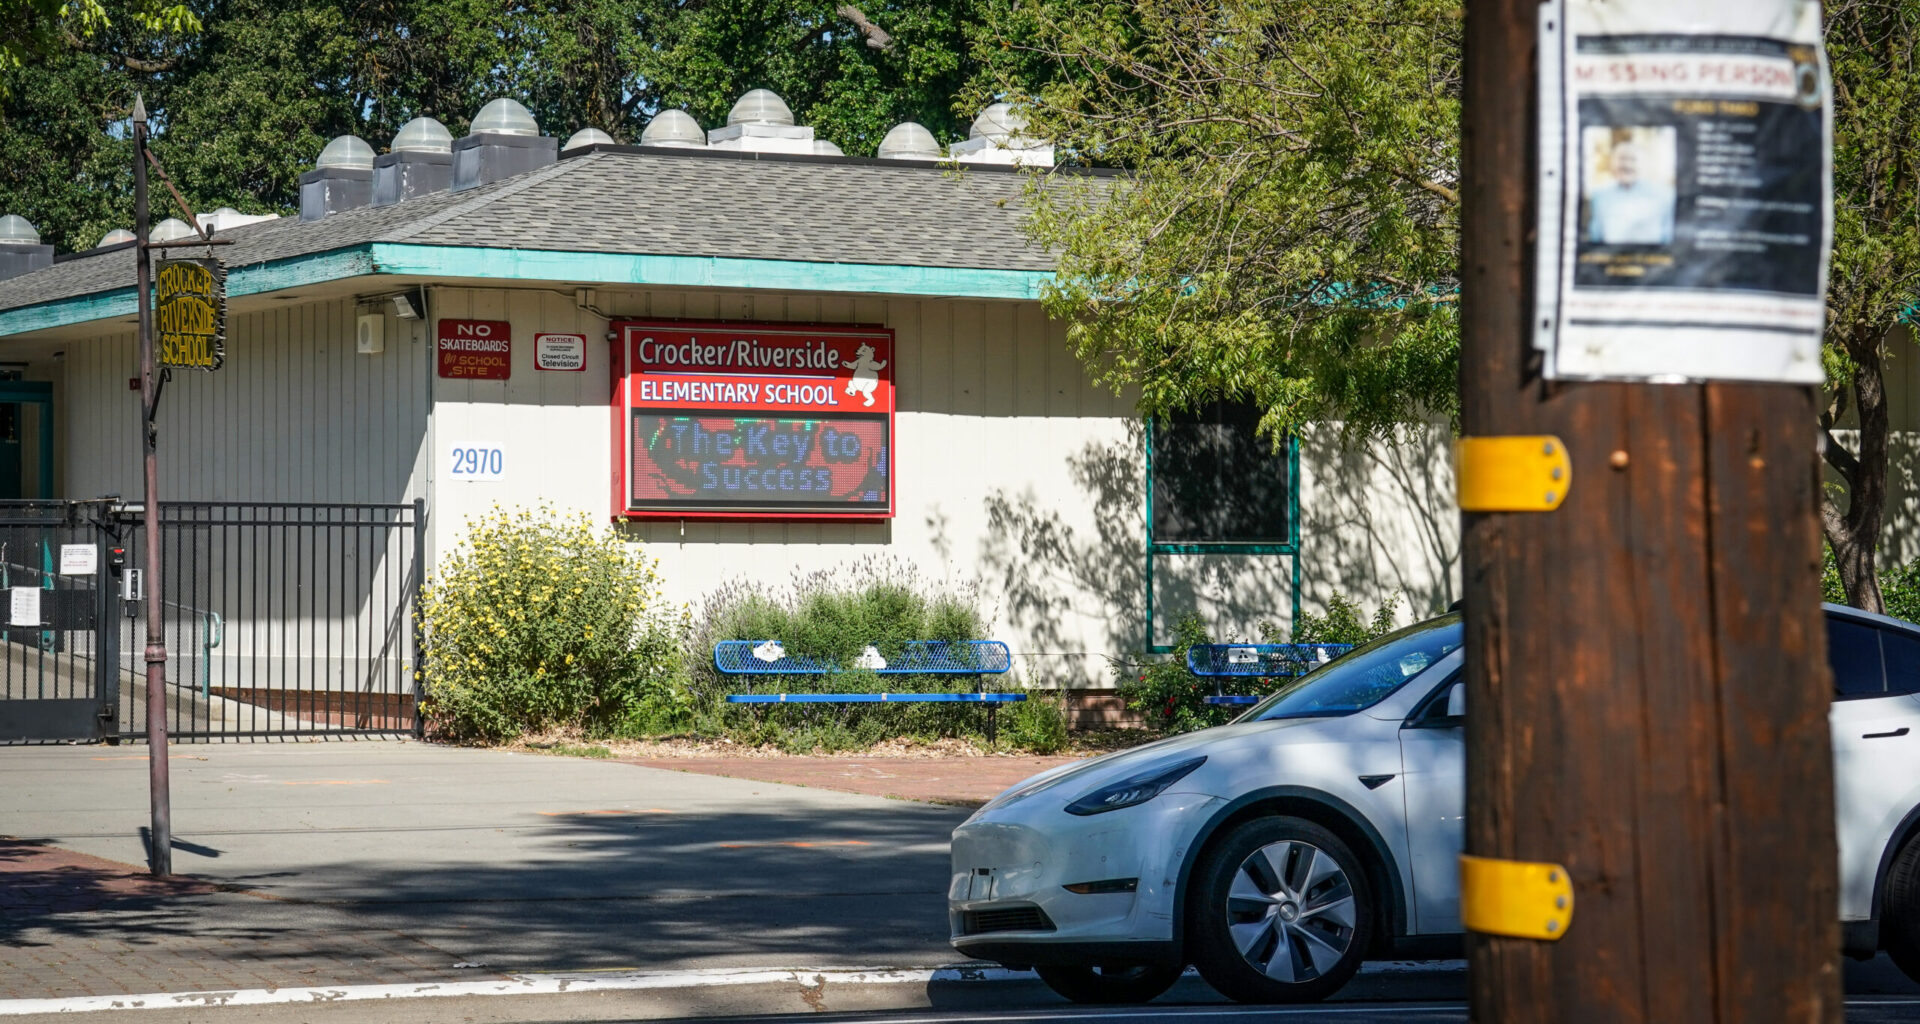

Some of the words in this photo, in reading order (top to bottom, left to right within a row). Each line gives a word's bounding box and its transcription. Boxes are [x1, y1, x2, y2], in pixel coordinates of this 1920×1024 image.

[1700, 63, 1794, 88] PERSON
[160, 264, 212, 305] CROCKER
[160, 296, 216, 334] RIVERSIDE
[457, 324, 491, 336] NO
[162, 333, 213, 367] SCHOOL
[440, 338, 509, 352] SKATEBOARDS
[638, 337, 840, 370] Crocker/Riverside
[452, 366, 488, 375] SITE
[459, 355, 506, 367] SCHOOL
[541, 359, 579, 368] Television
[640, 380, 760, 404] ELEMENTARY
[764, 384, 839, 405] SCHOOL
[671, 422, 732, 455] The
[747, 425, 809, 463] Key
[823, 430, 861, 457] to
[452, 448, 503, 474] 2970
[702, 461, 830, 490] Success
